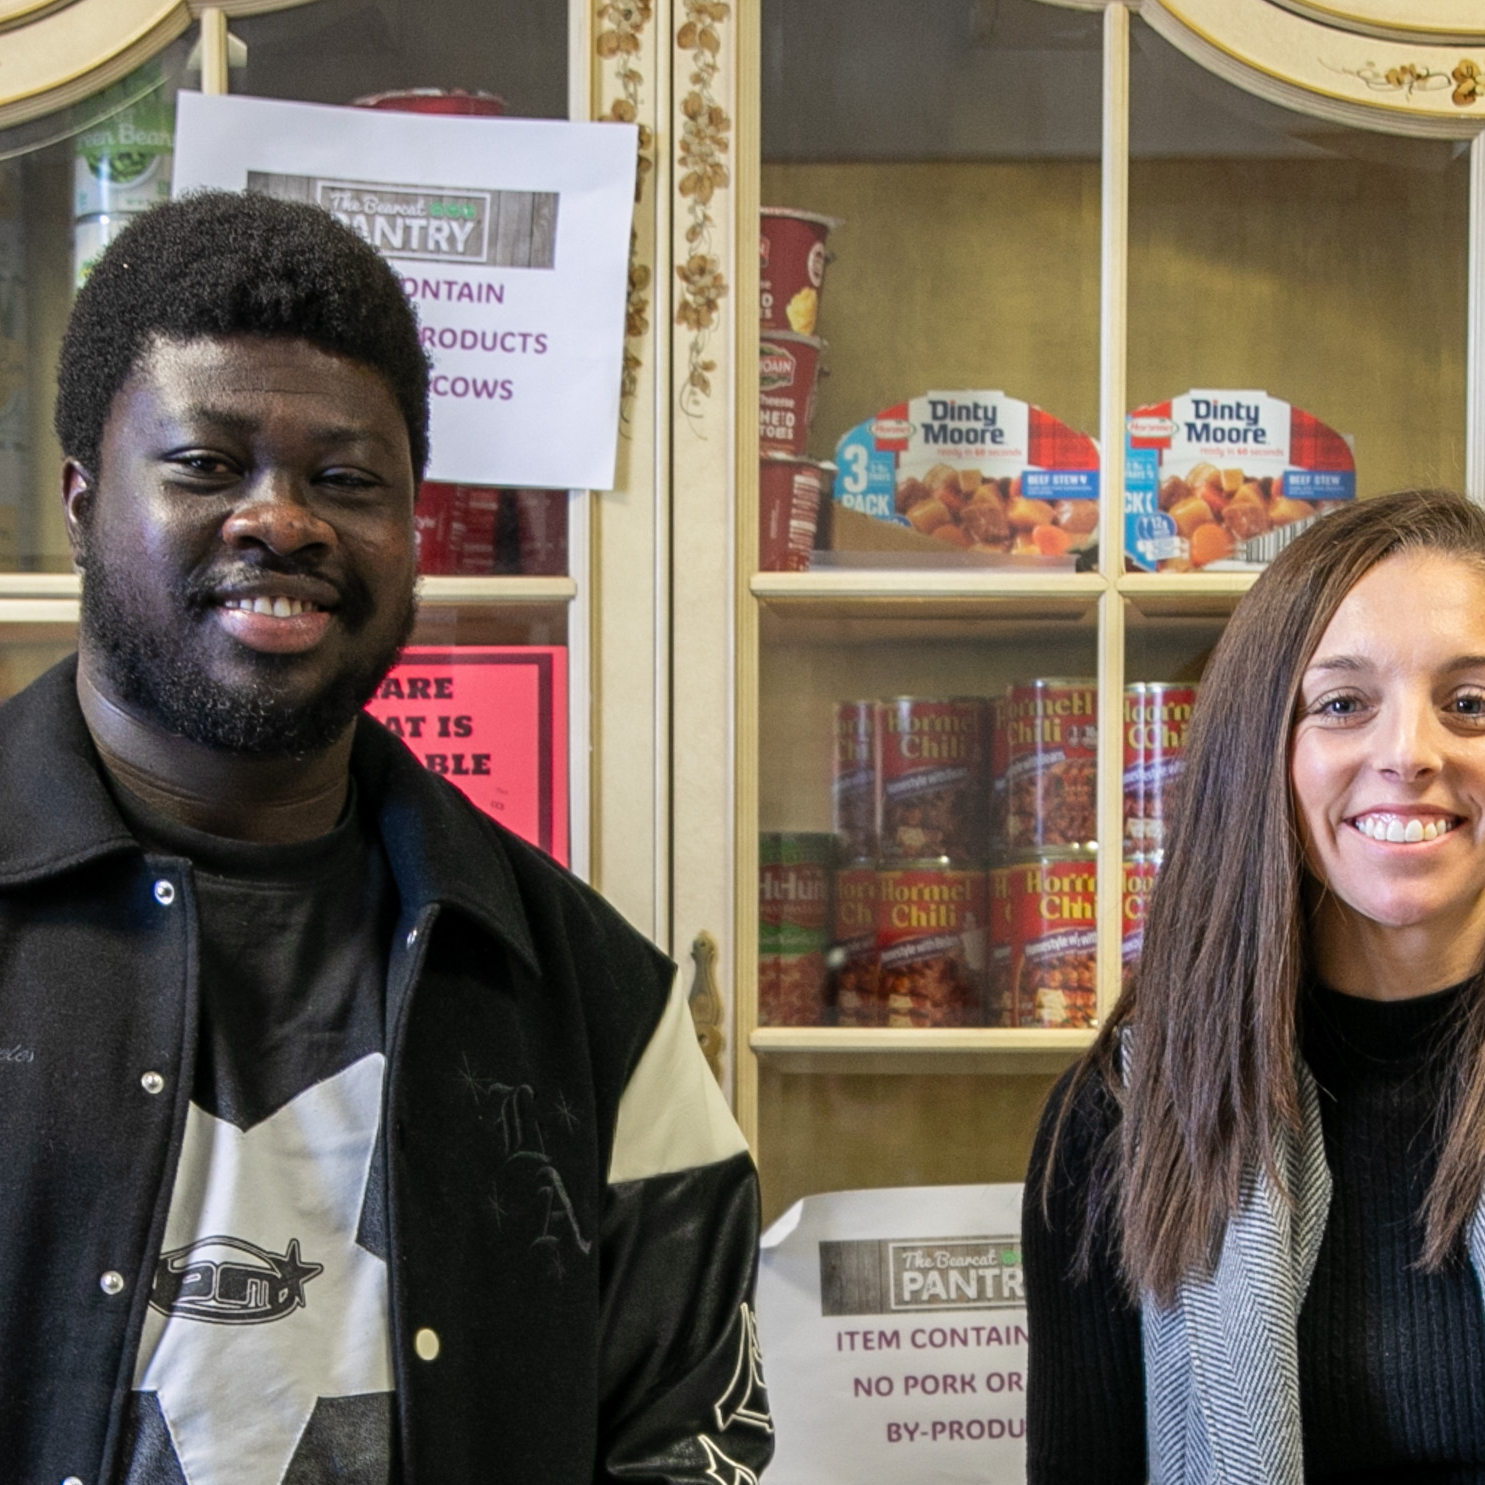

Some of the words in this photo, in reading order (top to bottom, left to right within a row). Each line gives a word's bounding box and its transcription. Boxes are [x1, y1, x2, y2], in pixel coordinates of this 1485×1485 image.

[330, 191, 360, 213] The
[363, 195, 427, 217] Bearcat
[433, 375, 513, 401] COWS
[928, 399, 997, 427] Dinty
[1192, 399, 1260, 426] Dinty
[921, 423, 1005, 446] Moore
[1185, 422, 1267, 445] Moore
[843, 444, 869, 493] 3
[1027, 474, 1050, 486] BEEF
[1289, 475, 1312, 486] BEEF
[1315, 475, 1341, 486] STEW
[841, 494, 890, 516] PACK
[373, 677, 453, 700] ARE
[438, 715, 473, 738] IS
[901, 736, 965, 758] Chili
[892, 904, 956, 928] Chili
[902, 1251, 934, 1268] The
[936, 1248, 997, 1268] Bearcat
[836, 1330, 901, 1352] ITEM
[853, 1376, 894, 1397] NO
[904, 1373, 977, 1396] PORK
[986, 1372, 1024, 1393] OR
[887, 1418, 1026, 1443] BY-PRODU
